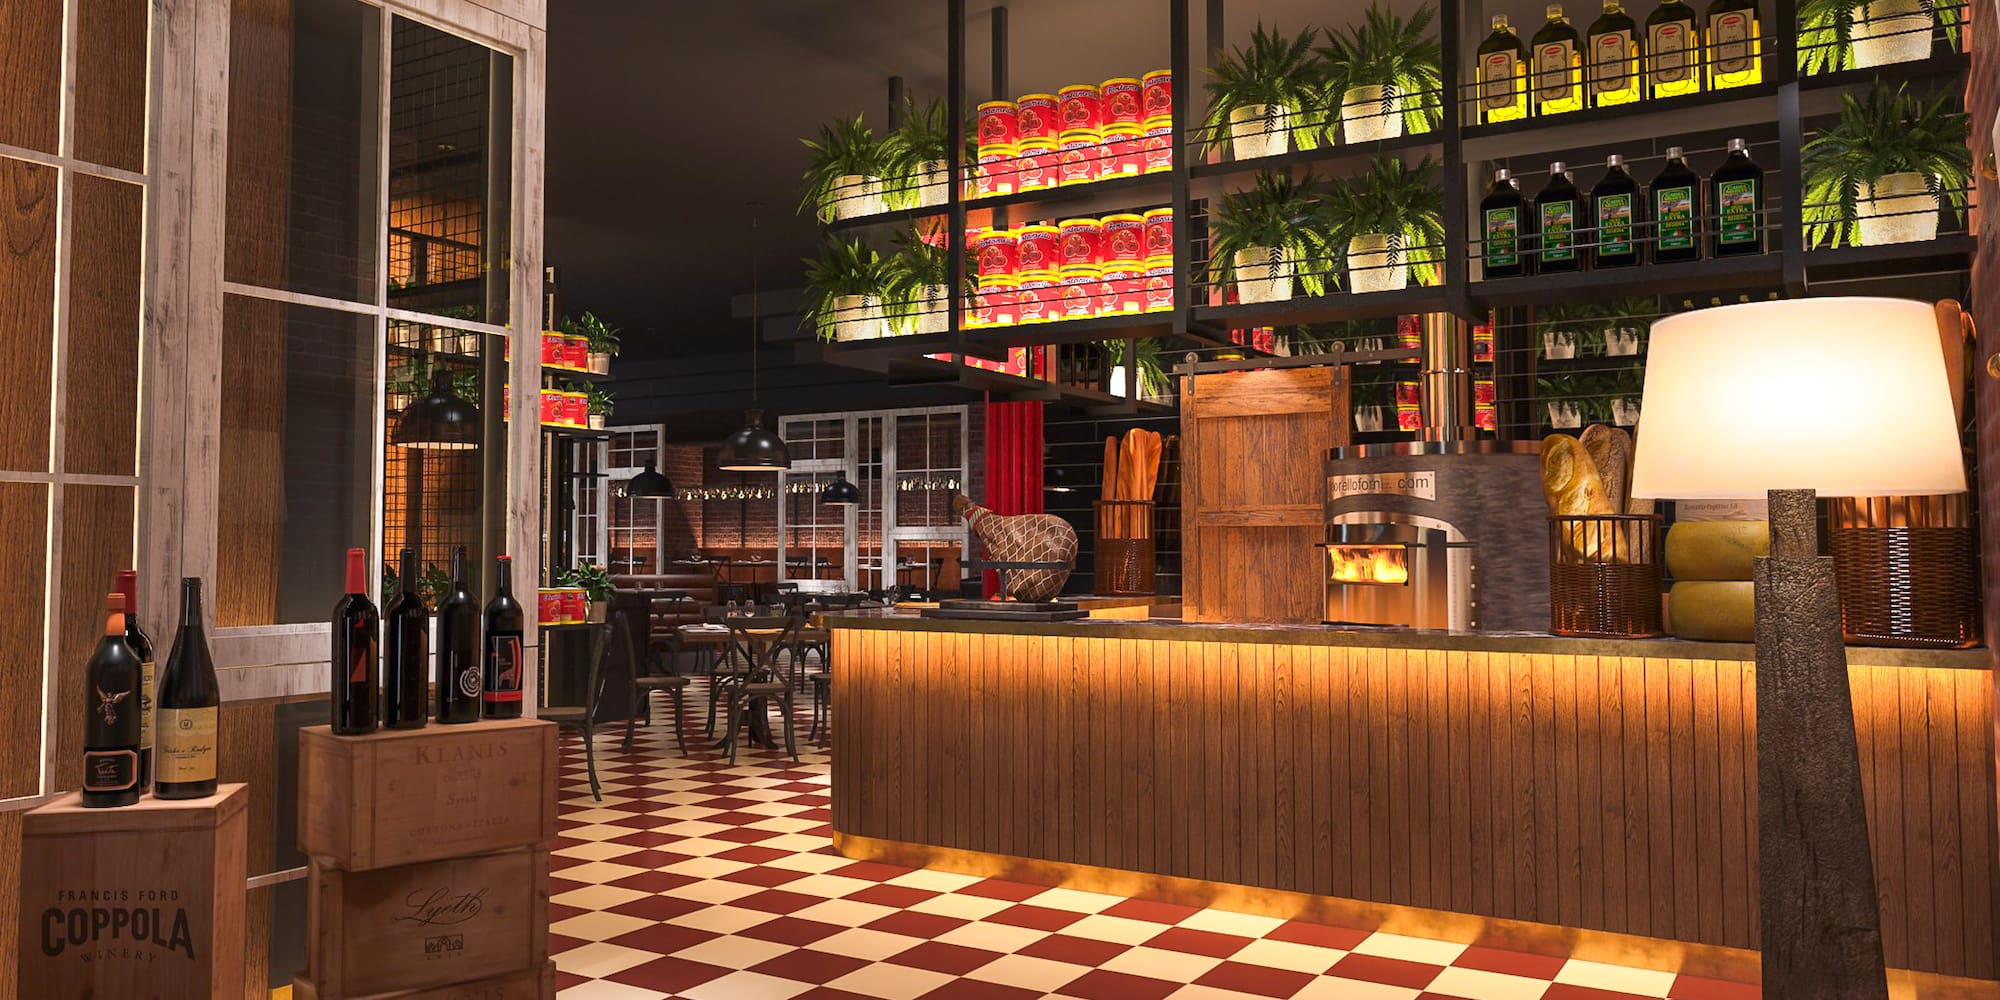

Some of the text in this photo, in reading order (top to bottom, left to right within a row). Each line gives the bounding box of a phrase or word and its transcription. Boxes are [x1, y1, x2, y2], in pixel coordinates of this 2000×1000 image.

[415, 741, 508, 766] KLANIS
[58, 890, 179, 902] FRANCIS FORD
[41, 907, 196, 962] COPPOLA
[80, 948, 157, 964] WINERY
